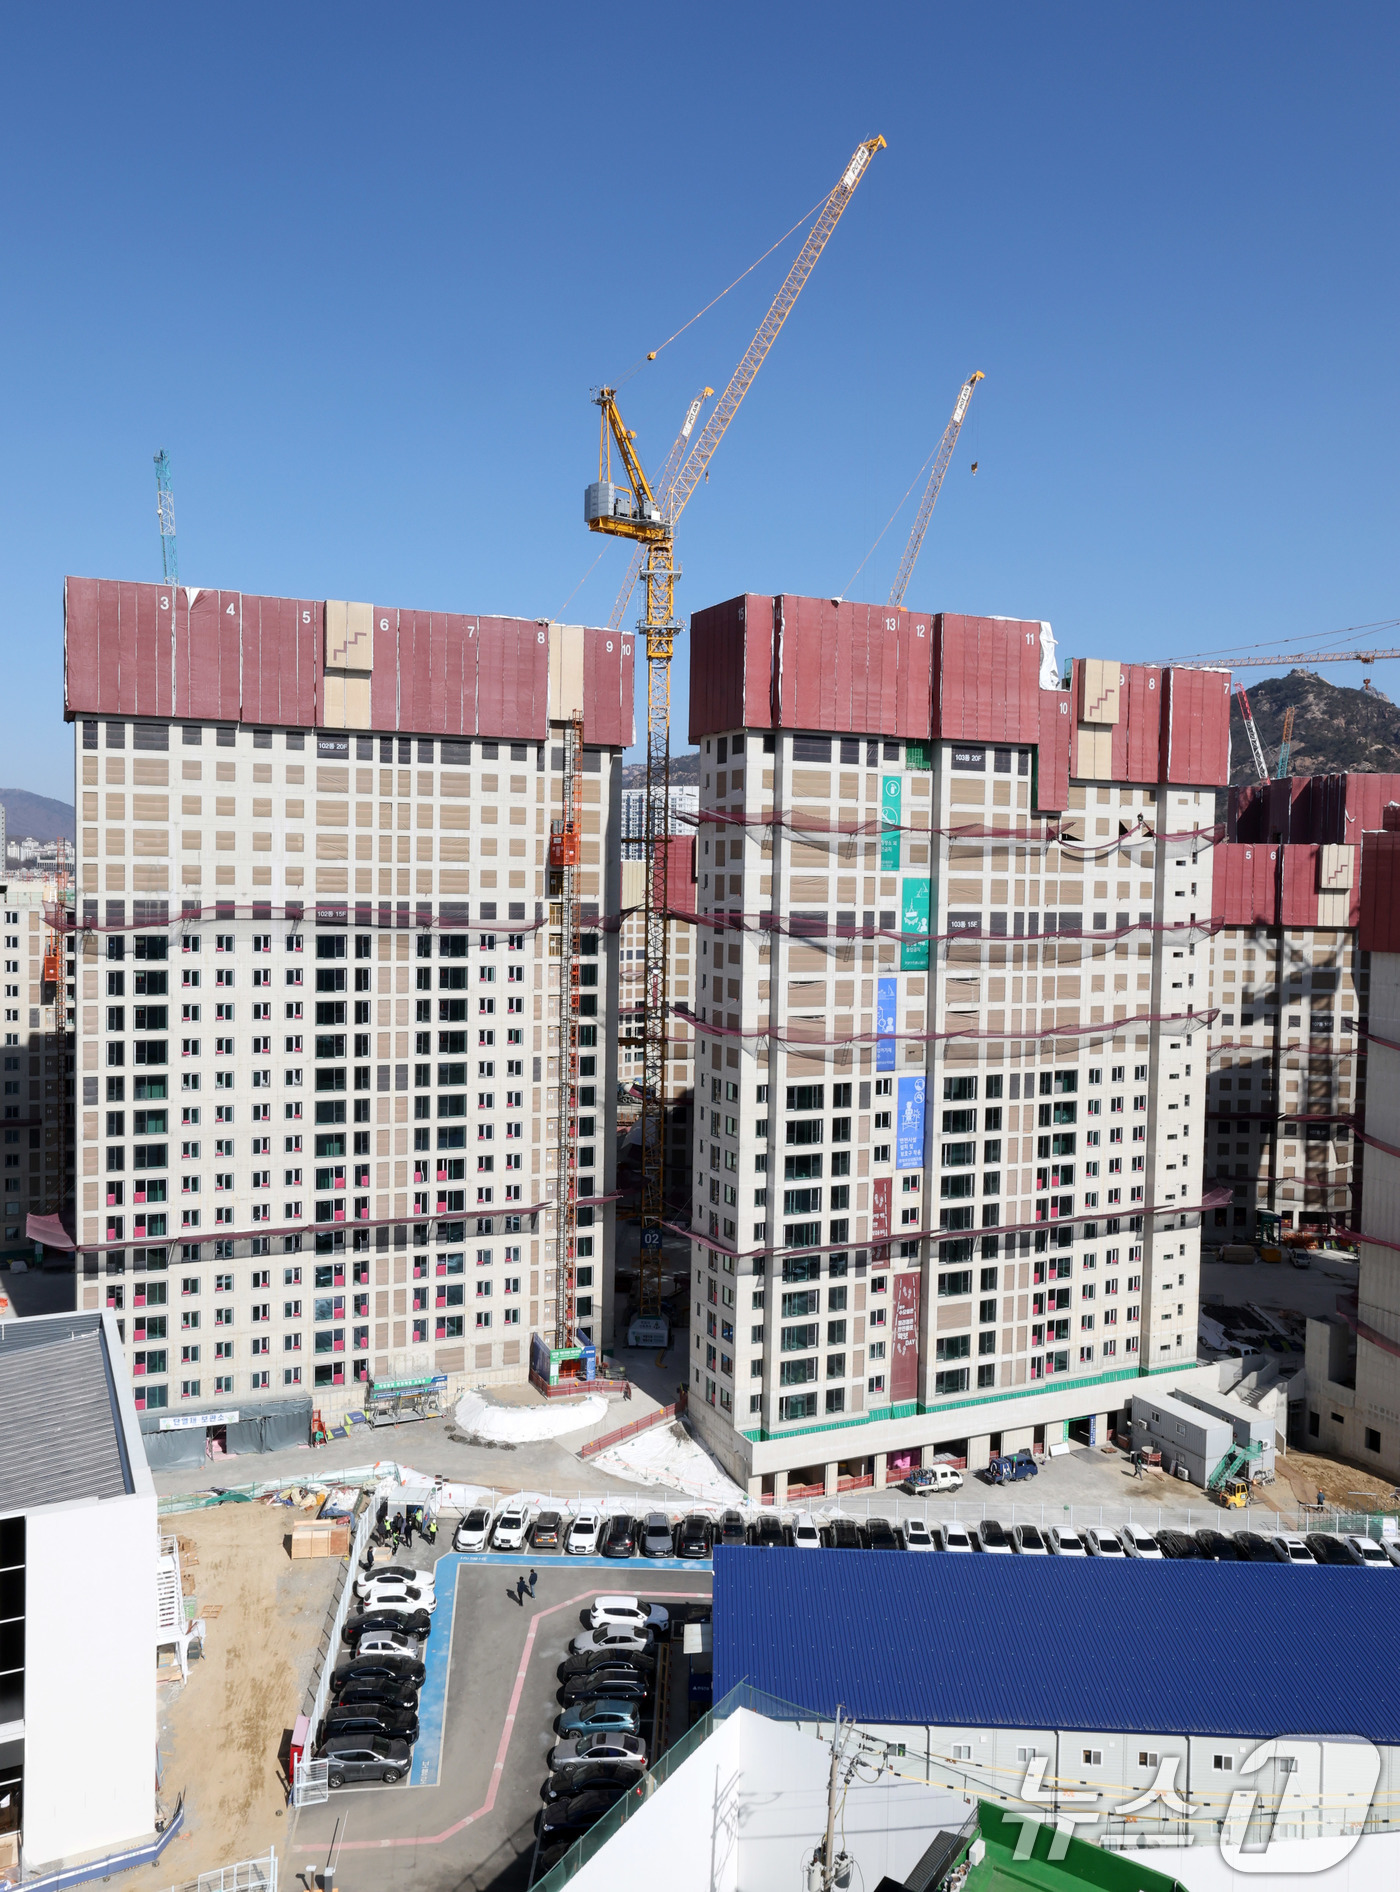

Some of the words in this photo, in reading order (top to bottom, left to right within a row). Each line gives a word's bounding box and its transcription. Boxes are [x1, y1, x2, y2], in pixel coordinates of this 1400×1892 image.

[958, 386, 970, 410] POTAIN
[687, 402, 699, 425] POTAIN
[160, 596, 170, 610] 3
[226, 602, 236, 616] 4
[302, 610, 311, 624] 5
[737, 607, 744, 621] 15
[380, 618, 390, 632] 6
[885, 617, 896, 631] 13
[915, 624, 926, 638] 12
[467, 625, 476, 639] 7
[537, 631, 546, 645] 8
[1025, 632, 1035, 646] 11
[606, 640, 614, 653] 9
[622, 644, 632, 656] 10
[1148, 677, 1156, 690] 8
[1223, 682, 1230, 695] 7
[1059, 702, 1068, 715] 10
[971, 754, 982, 762] 20F
[1245, 850, 1252, 860] 5
[1270, 851, 1277, 861] 6
[644, 1233, 660, 1244] 02
[173, 1416, 197, 1426] 단열재
[201, 1413, 225, 1423] 보관소
